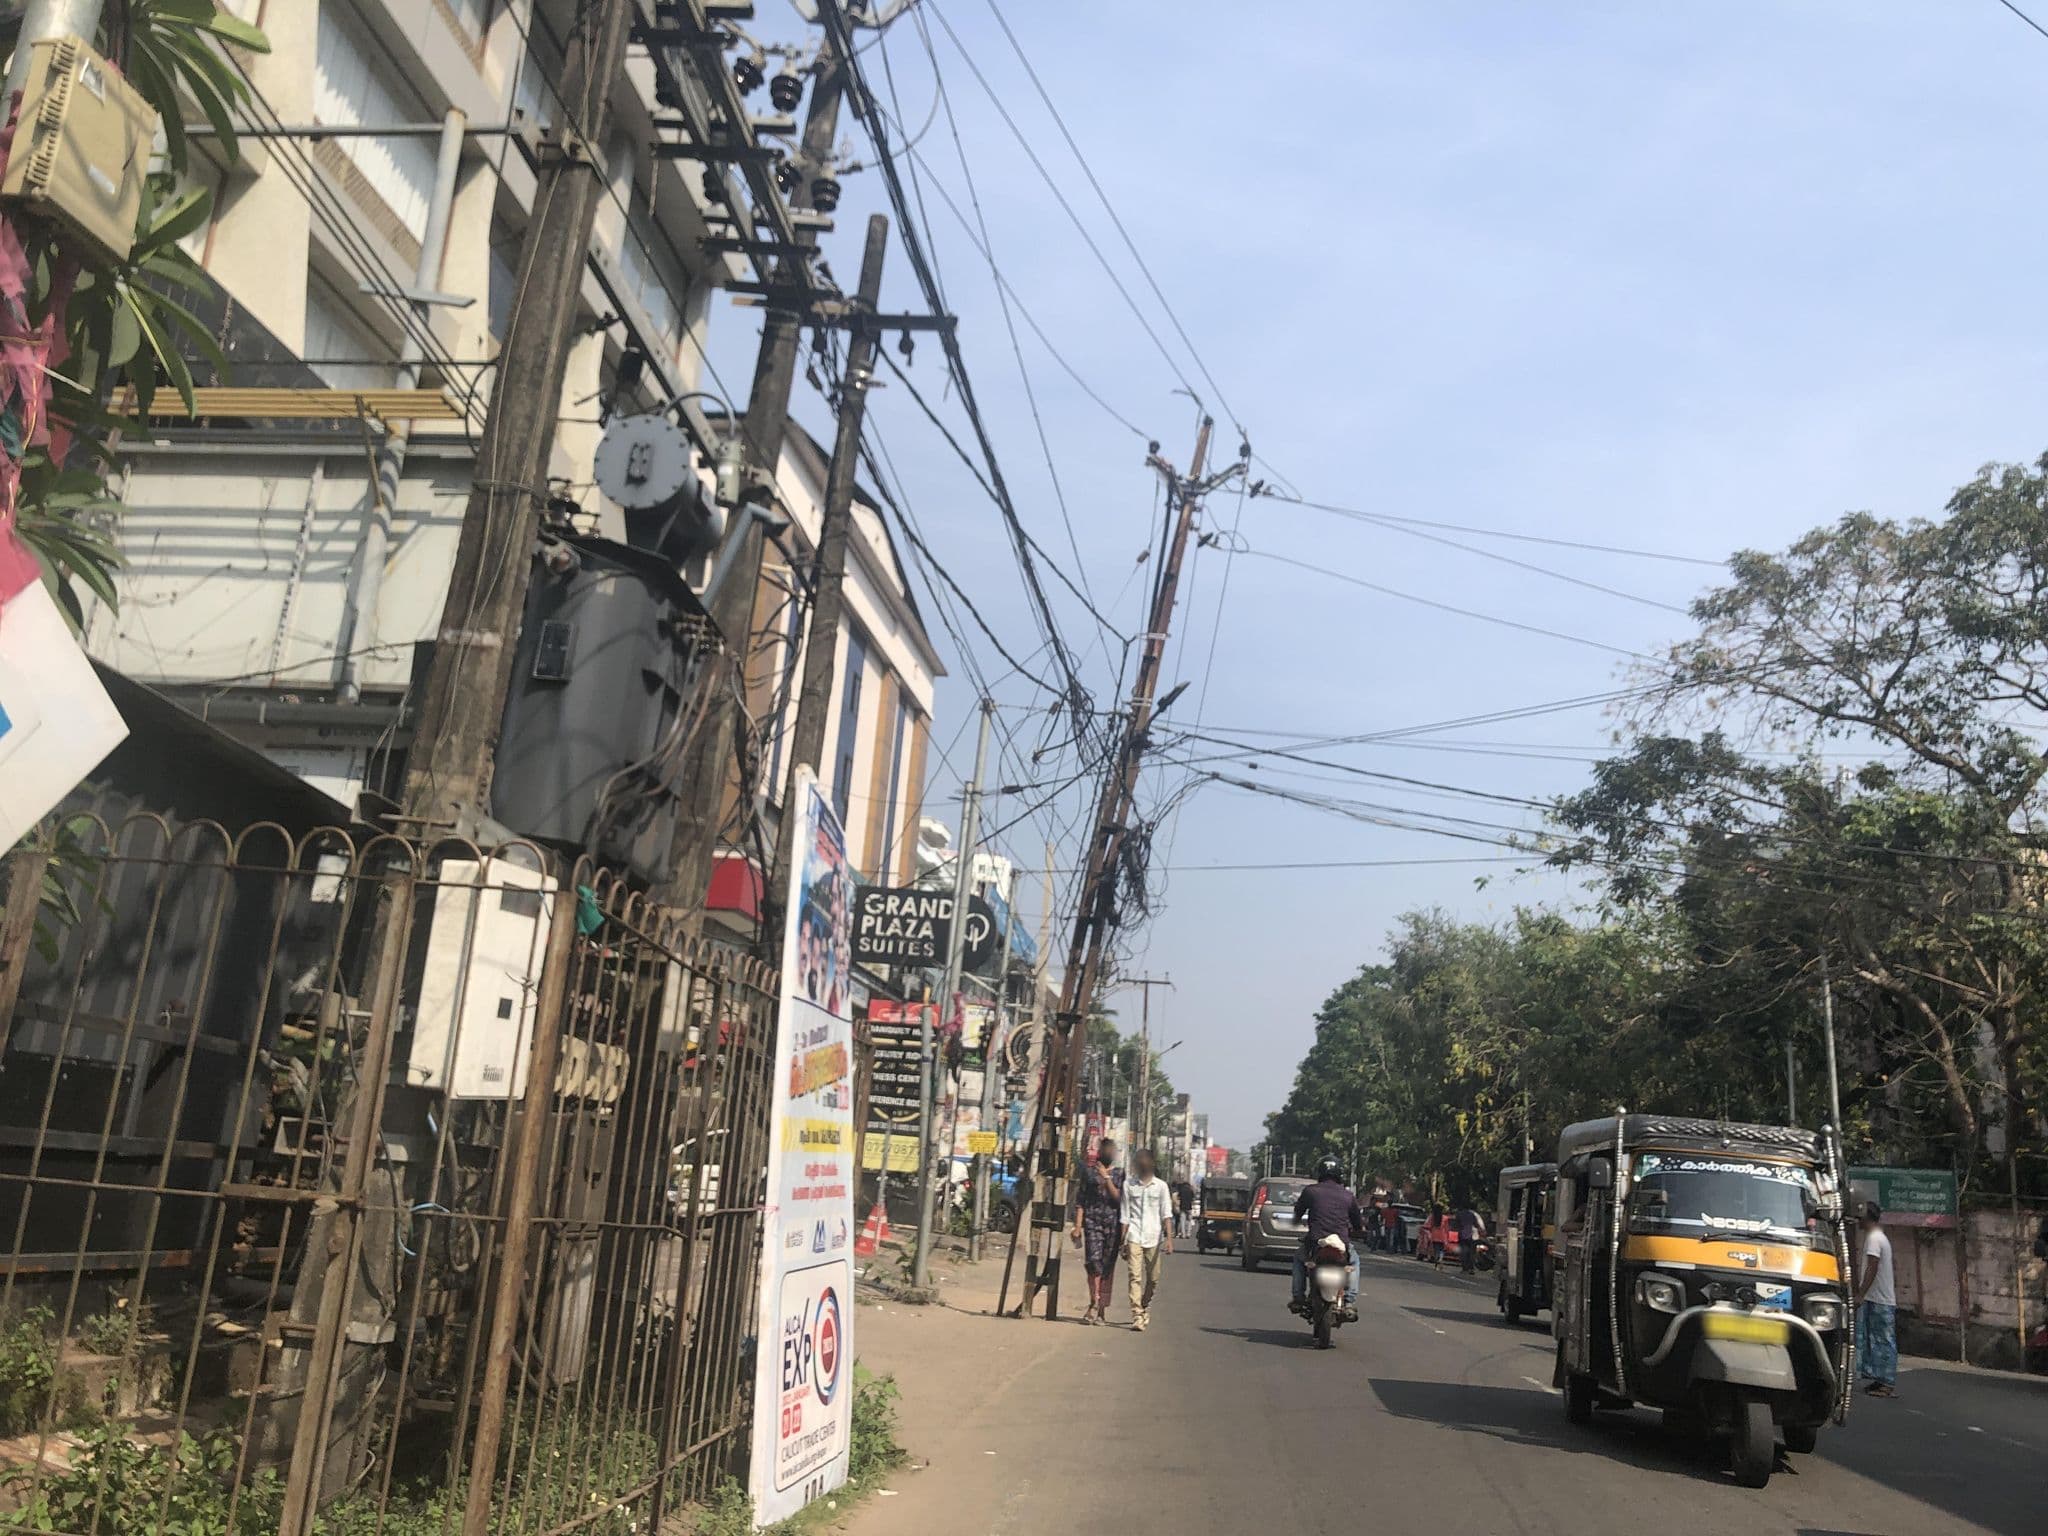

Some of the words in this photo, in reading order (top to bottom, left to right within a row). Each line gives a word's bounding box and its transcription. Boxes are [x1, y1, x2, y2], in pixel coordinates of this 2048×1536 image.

[864, 893, 953, 919] GRAND
[861, 914, 935, 940] PLAZA
[858, 937, 935, 957] SUITES
